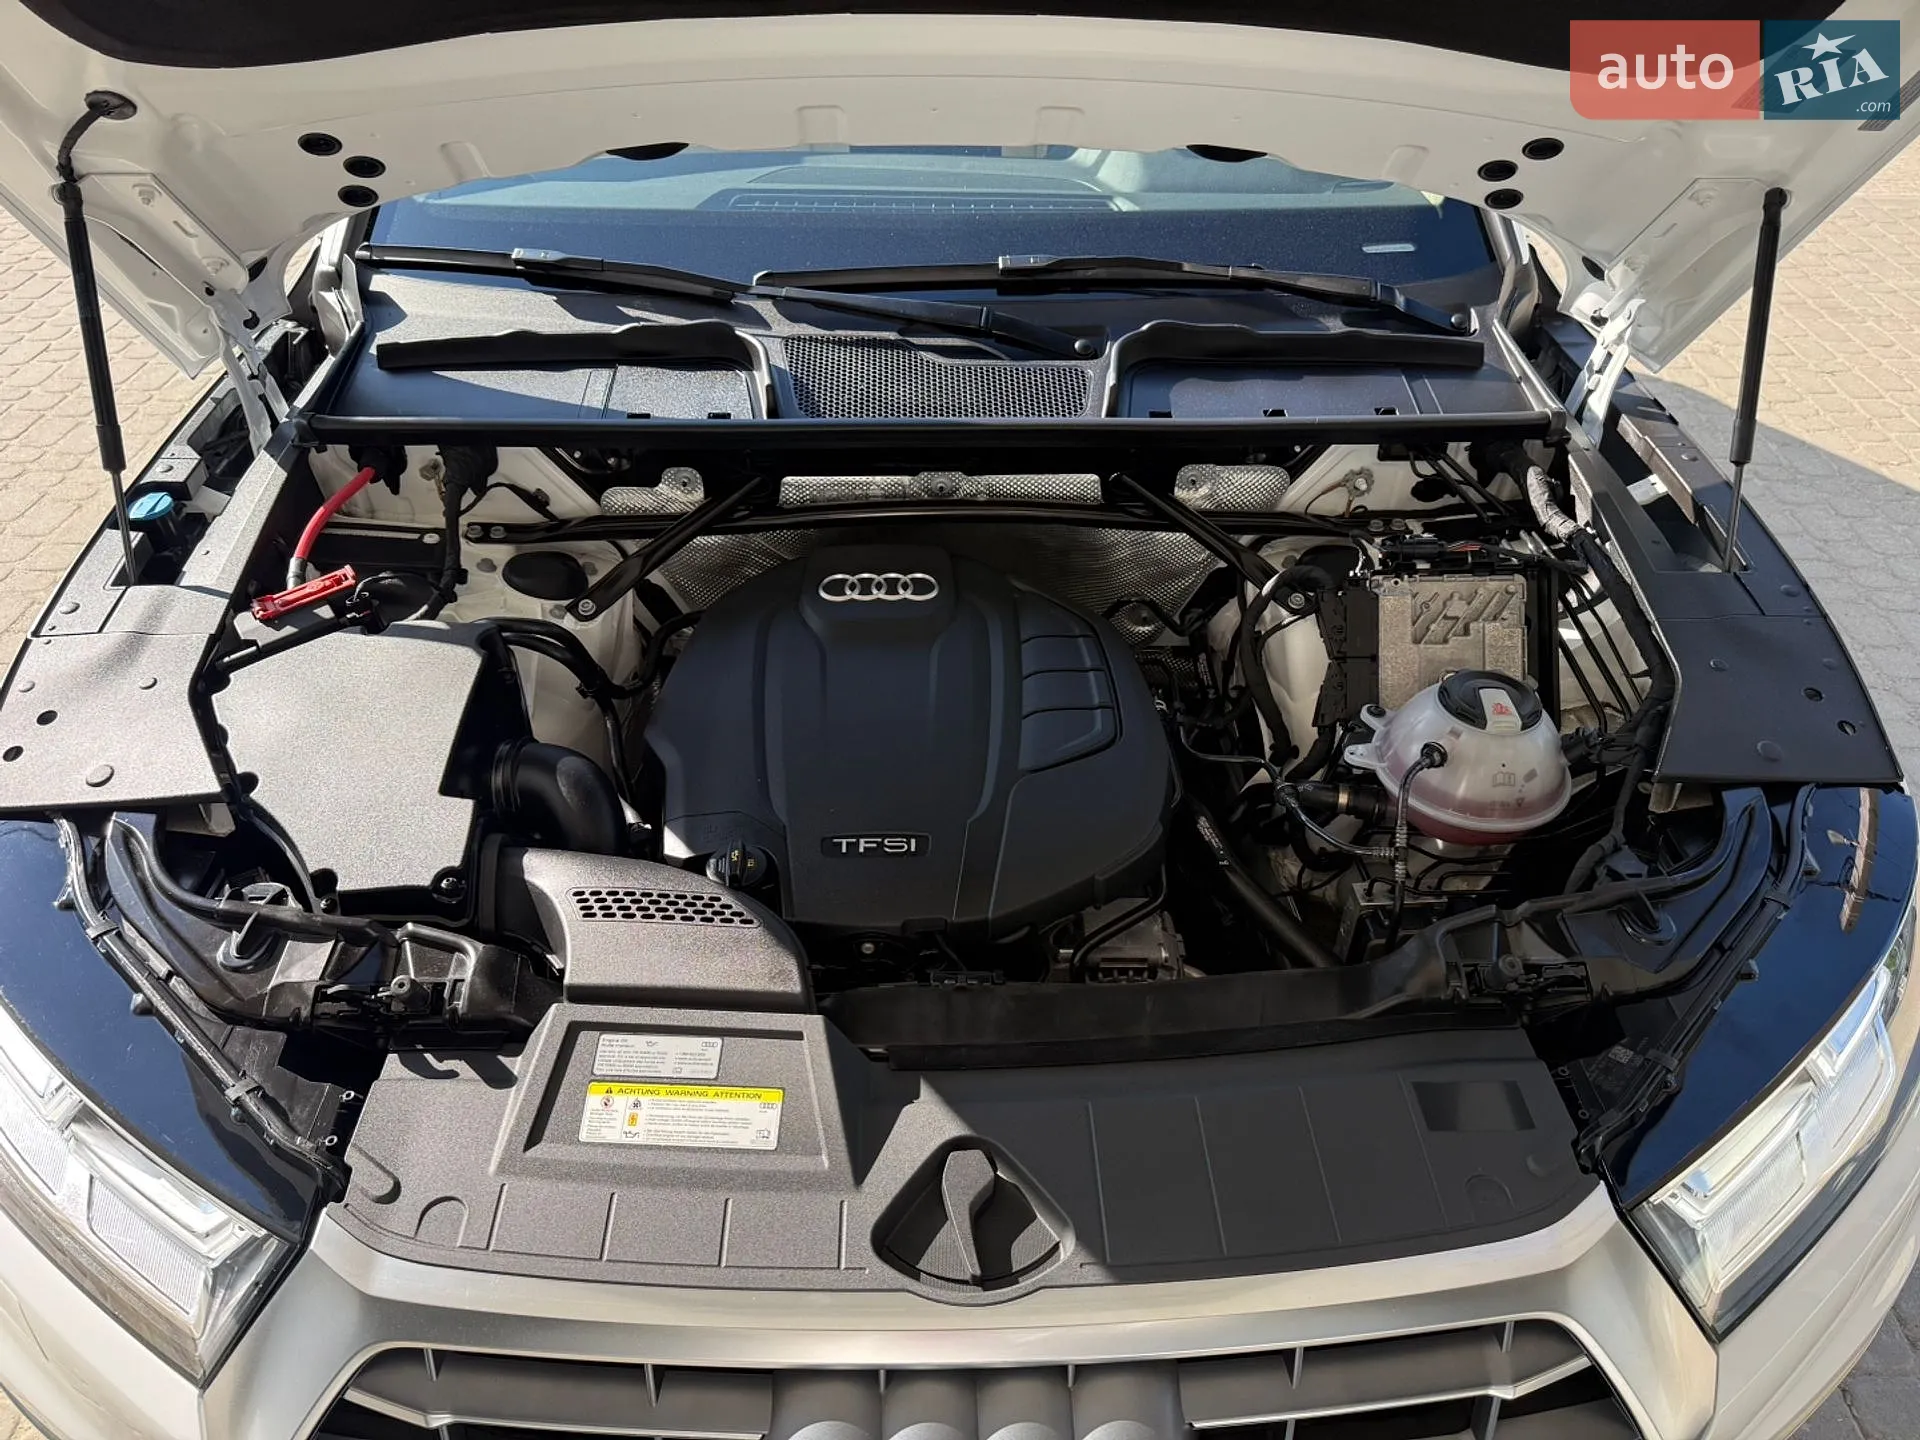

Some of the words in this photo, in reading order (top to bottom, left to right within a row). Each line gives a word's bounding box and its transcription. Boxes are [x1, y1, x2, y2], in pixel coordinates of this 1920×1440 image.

[832, 837, 916, 853] TFSI
[617, 1087, 660, 1096] ACHTUNG
[665, 1089, 709, 1098] WARNING
[713, 1091, 763, 1099] ATTENTION
